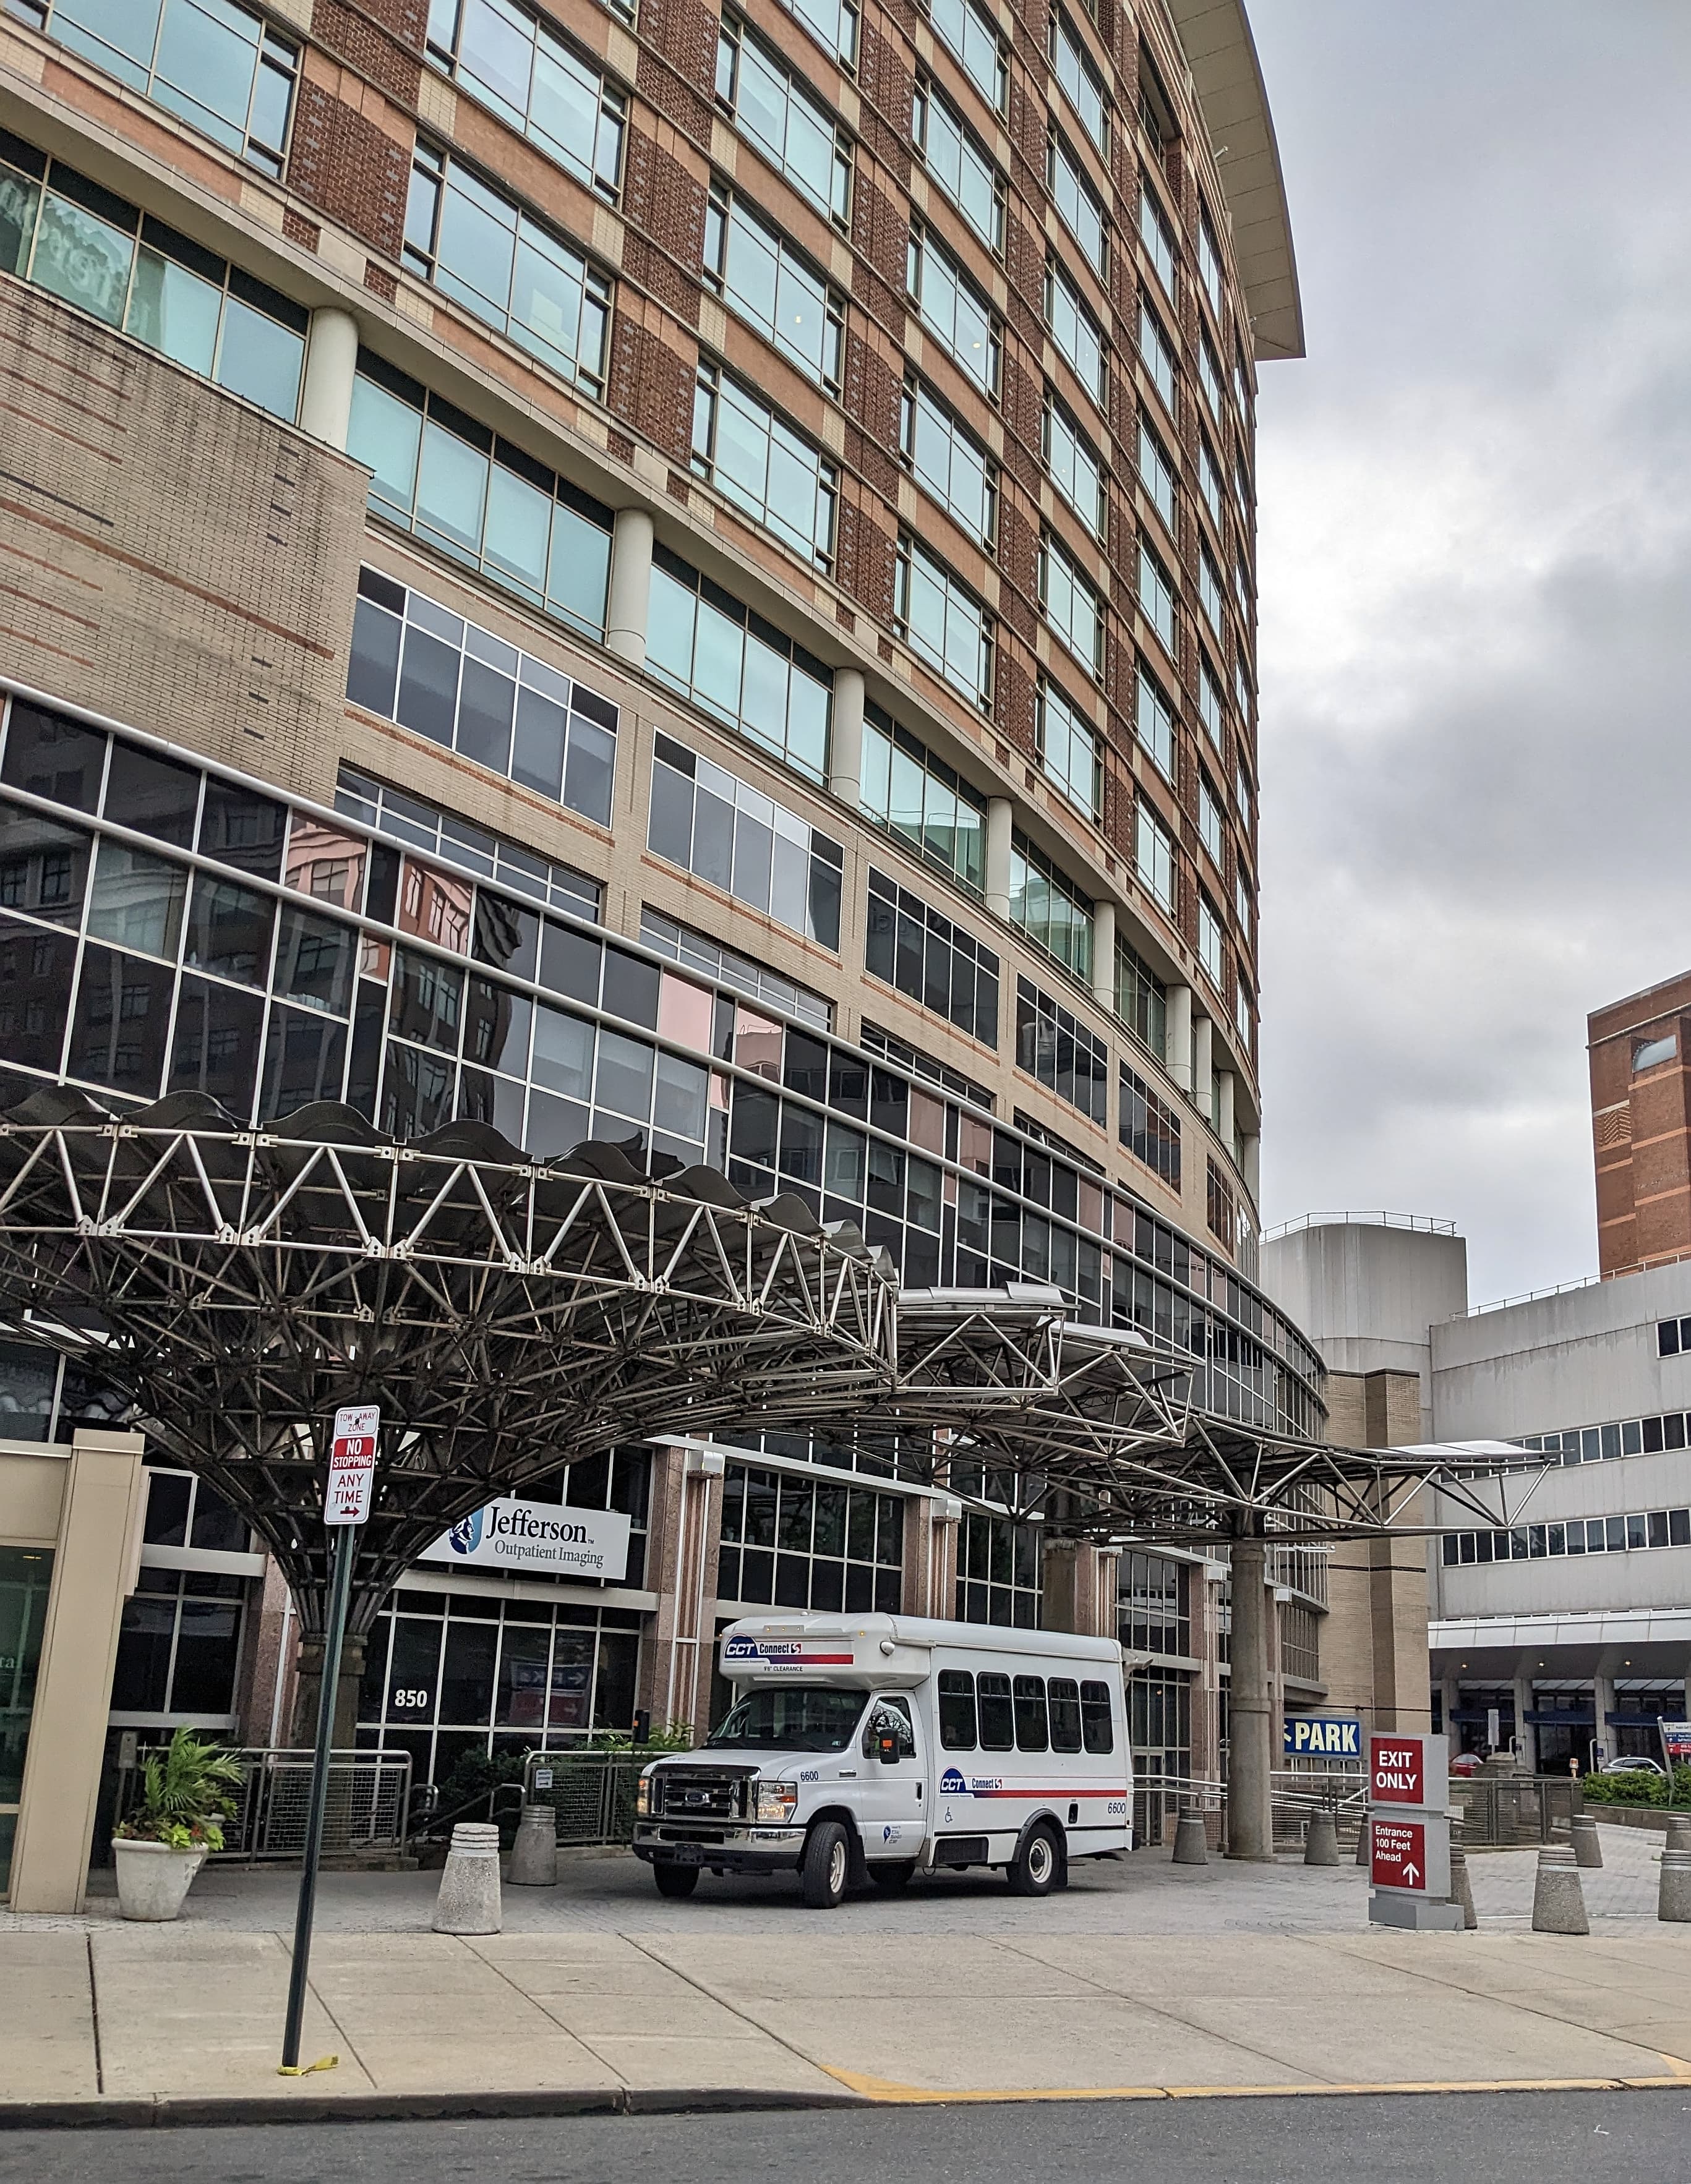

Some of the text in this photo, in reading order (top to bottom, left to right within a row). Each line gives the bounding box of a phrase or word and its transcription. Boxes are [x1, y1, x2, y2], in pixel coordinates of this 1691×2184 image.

[340, 1414, 353, 1422] TOW
[359, 1412, 375, 1420] AWAY
[348, 1423, 366, 1431] ZONE
[346, 1439, 362, 1456] NO
[333, 1455, 372, 1468] STOPPING
[337, 1474, 364, 1487] ANY
[335, 1491, 363, 1504] TIME
[486, 1506, 586, 1543] Jefferson
[495, 1540, 604, 1569] Outpatient Imaging
[726, 1643, 789, 1655] CCT Connect
[395, 1689, 427, 1707] 850
[1295, 1721, 1357, 1752] PARK
[1379, 1751, 1413, 1768] EXIT
[800, 1770, 819, 1781] 6600
[1376, 1772, 1417, 1789] ONLY
[941, 1778, 994, 1791] CCT Connect
[1108, 1802, 1126, 1814] 6600
[1375, 1825, 1413, 1838] Entrance
[1376, 1838, 1411, 1851] 100 Feet
[1375, 1850, 1402, 1862] Ahead
